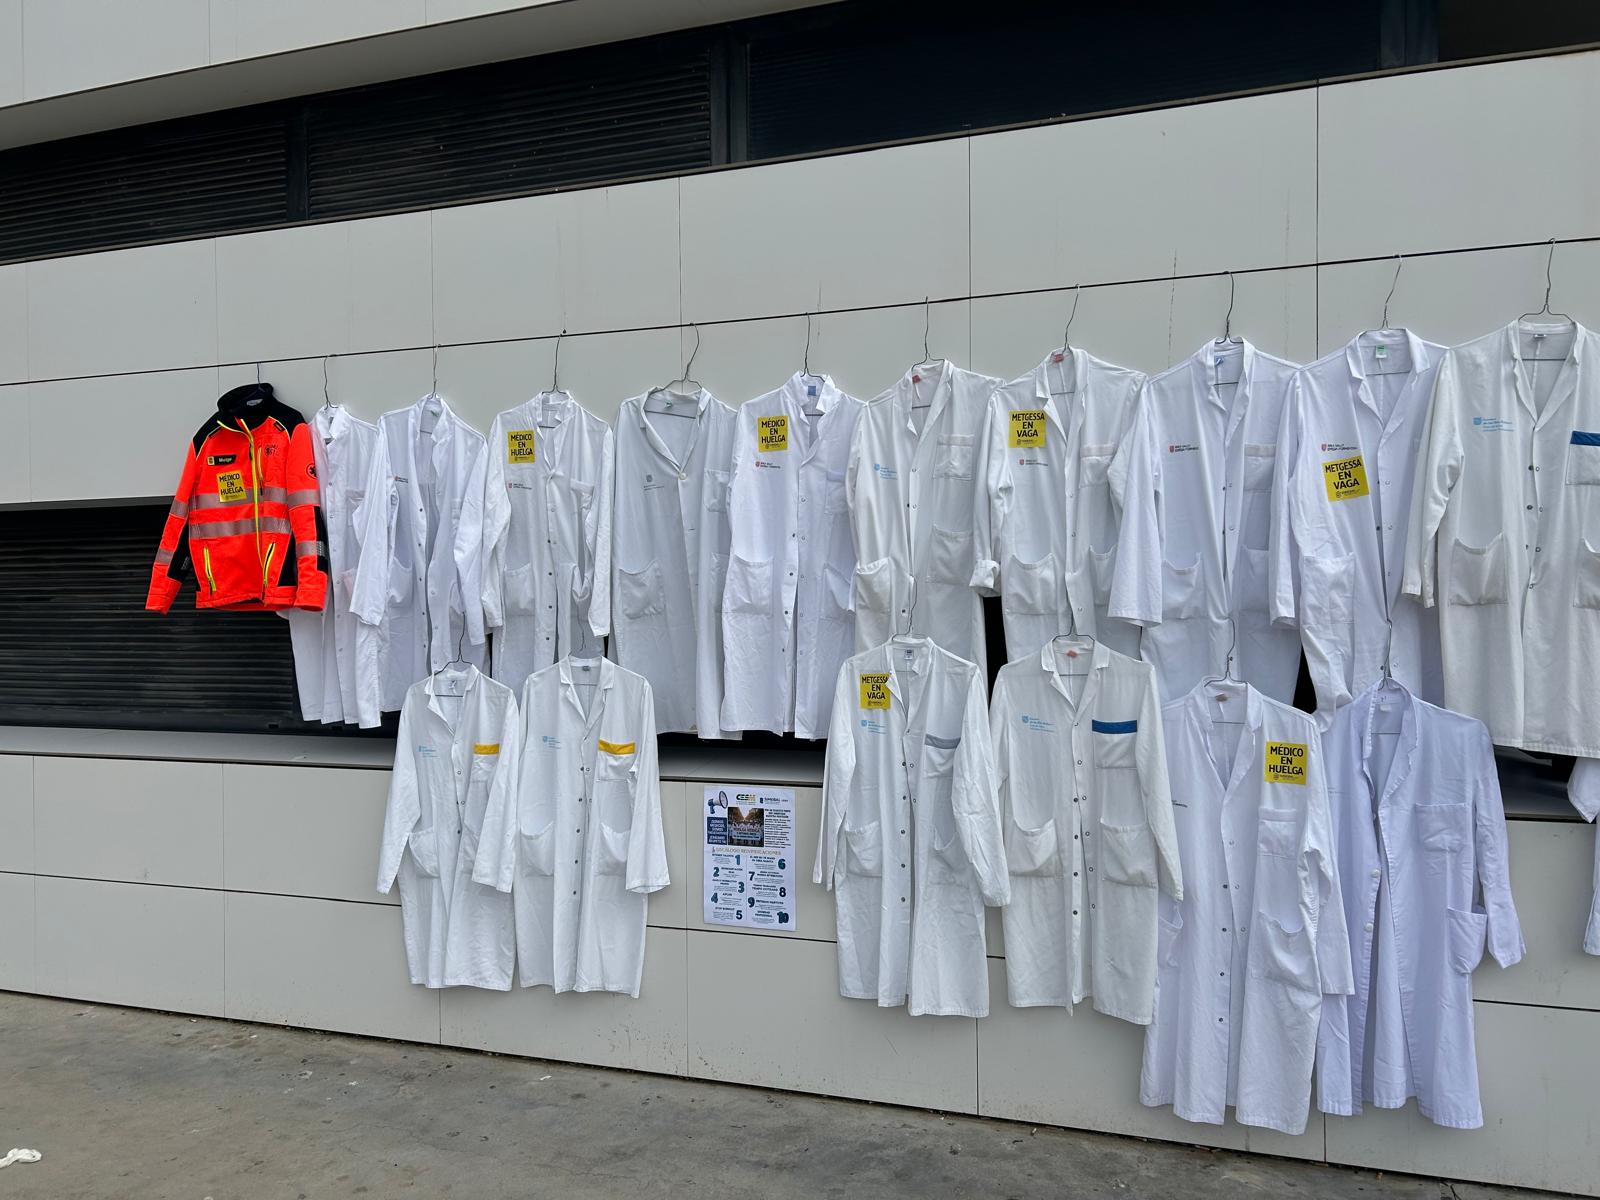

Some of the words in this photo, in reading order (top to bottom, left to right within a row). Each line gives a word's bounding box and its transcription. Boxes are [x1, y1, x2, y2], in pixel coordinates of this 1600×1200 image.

[1011, 413, 1045, 421] METGESSA
[761, 418, 785, 428] MÉDICO
[1022, 421, 1034, 429] EN
[510, 432, 532, 441] MÉDICO
[1016, 429, 1039, 437] VAGA
[761, 435, 786, 443] HUELGA
[510, 448, 533, 456] HUELGA
[1325, 459, 1362, 473] METGESSA
[219, 473, 240, 482] MÉDICO
[1337, 470, 1352, 480] EN
[1333, 478, 1360, 490] VAGA
[220, 486, 244, 495] HUELGA
[867, 692, 886, 700] VAGA
[1270, 743, 1304, 757] MÉDICO
[1280, 756, 1293, 765] EN
[1268, 764, 1304, 775] HUELGA
[735, 855, 741, 865] 1
[778, 859, 786, 870] 6
[713, 867, 720, 877] 2
[748, 871, 755, 881] 7
[738, 881, 745, 893] 3
[779, 887, 786, 897] 8
[711, 892, 719, 903] 4
[748, 897, 755, 908] 9
[736, 910, 743, 920] 5
[777, 911, 789, 924] 10
